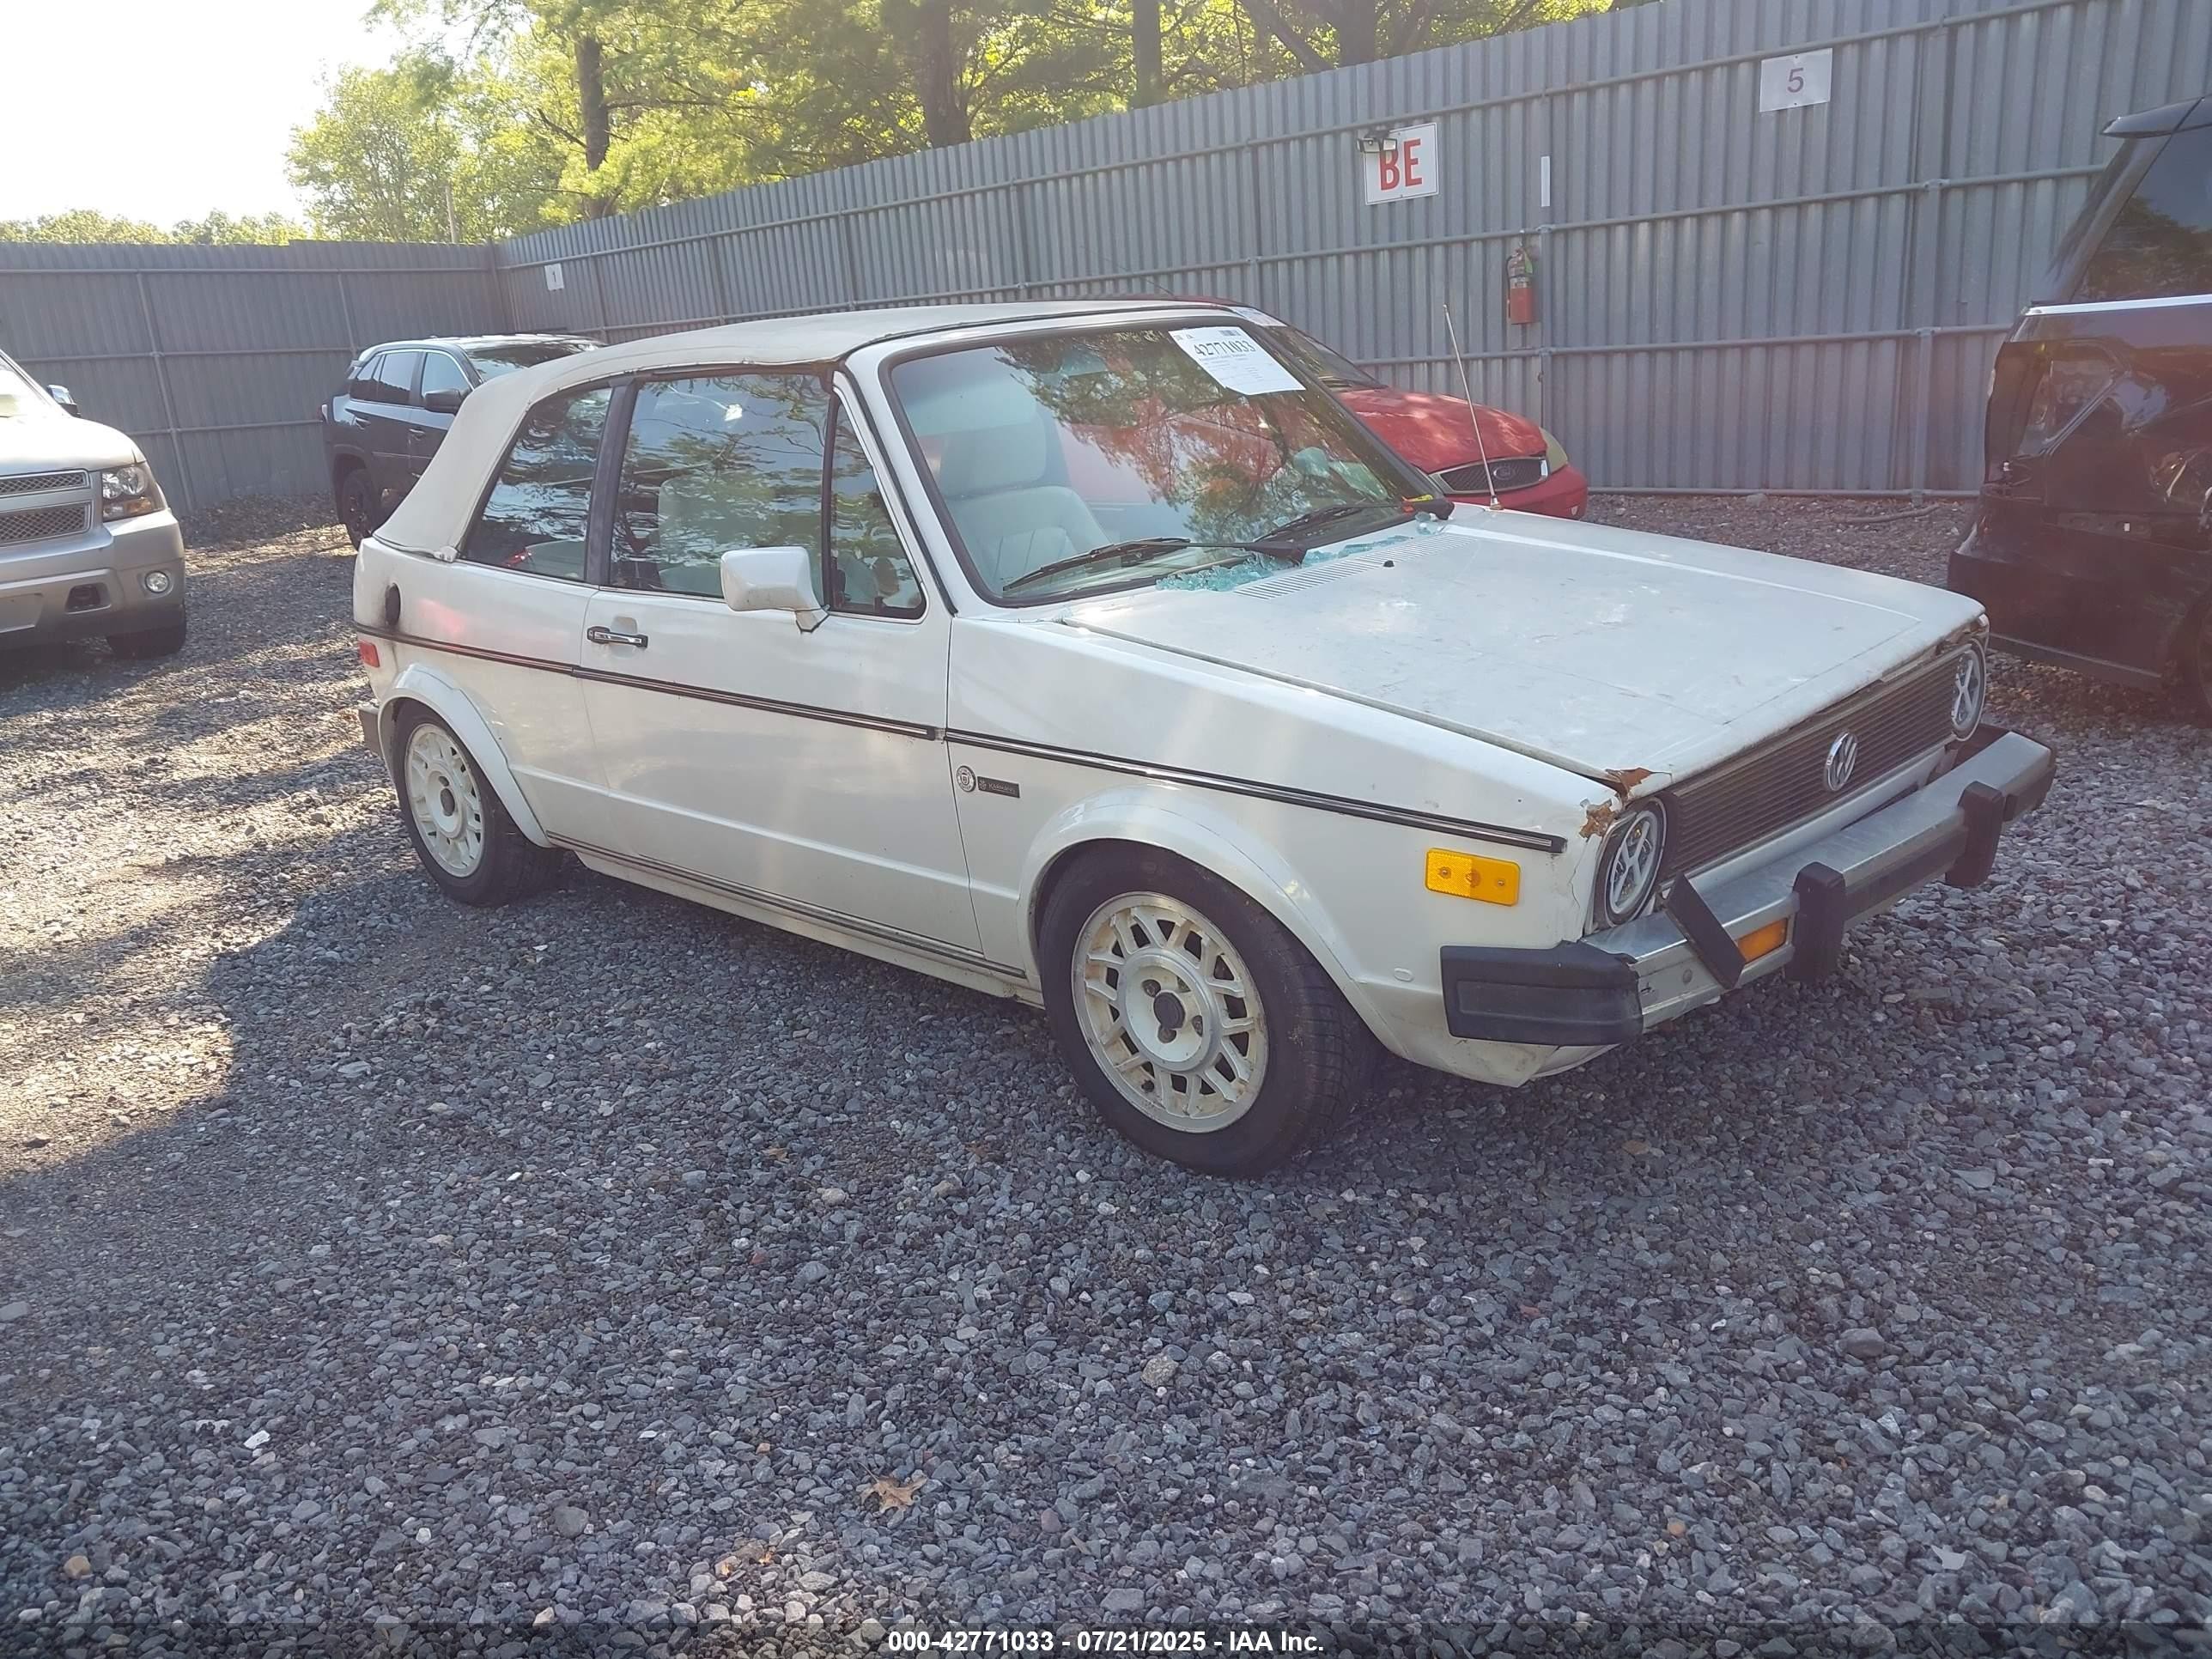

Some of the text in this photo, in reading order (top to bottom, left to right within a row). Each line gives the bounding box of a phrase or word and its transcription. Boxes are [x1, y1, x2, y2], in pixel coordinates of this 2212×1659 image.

[1787, 67, 1804, 93] 5
[1379, 137, 1423, 191] BE
[1194, 340, 1255, 356] 42771033
